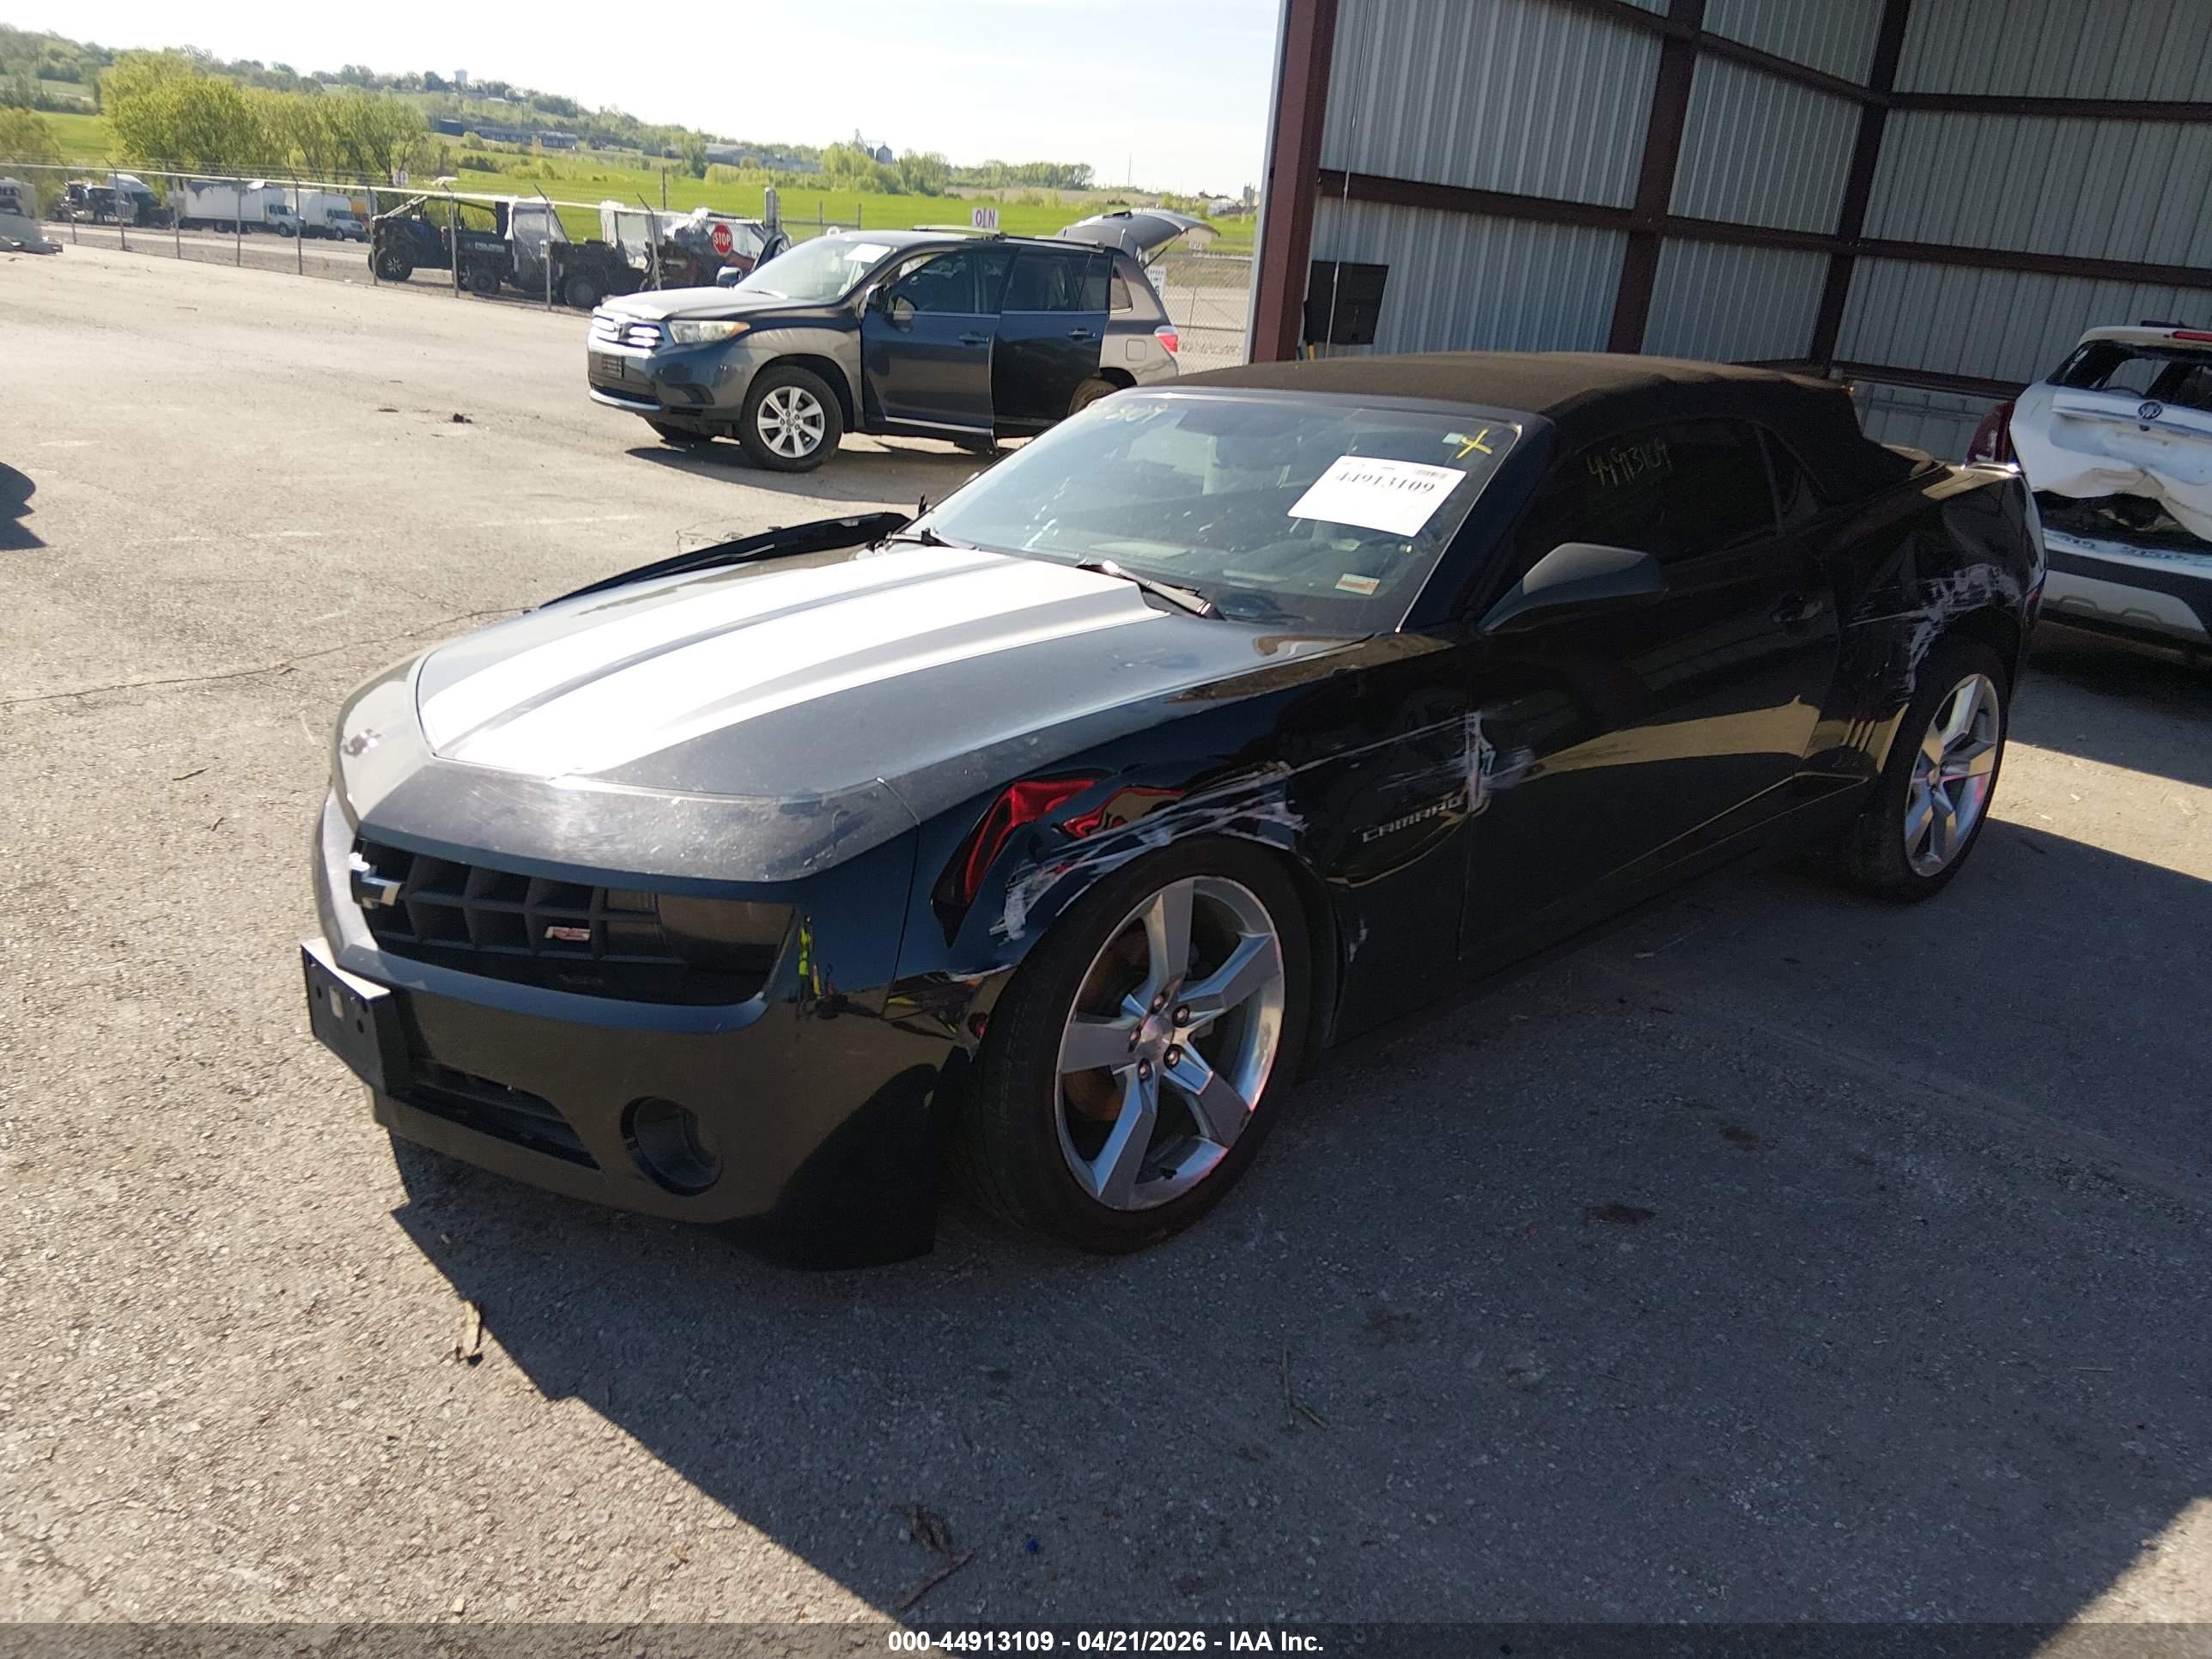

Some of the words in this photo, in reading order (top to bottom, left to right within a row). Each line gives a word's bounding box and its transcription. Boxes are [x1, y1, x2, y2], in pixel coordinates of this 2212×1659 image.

[714, 232, 731, 246] STOP
[1334, 471, 1436, 494] 44913109
[1362, 794, 1465, 843] CAMARO
